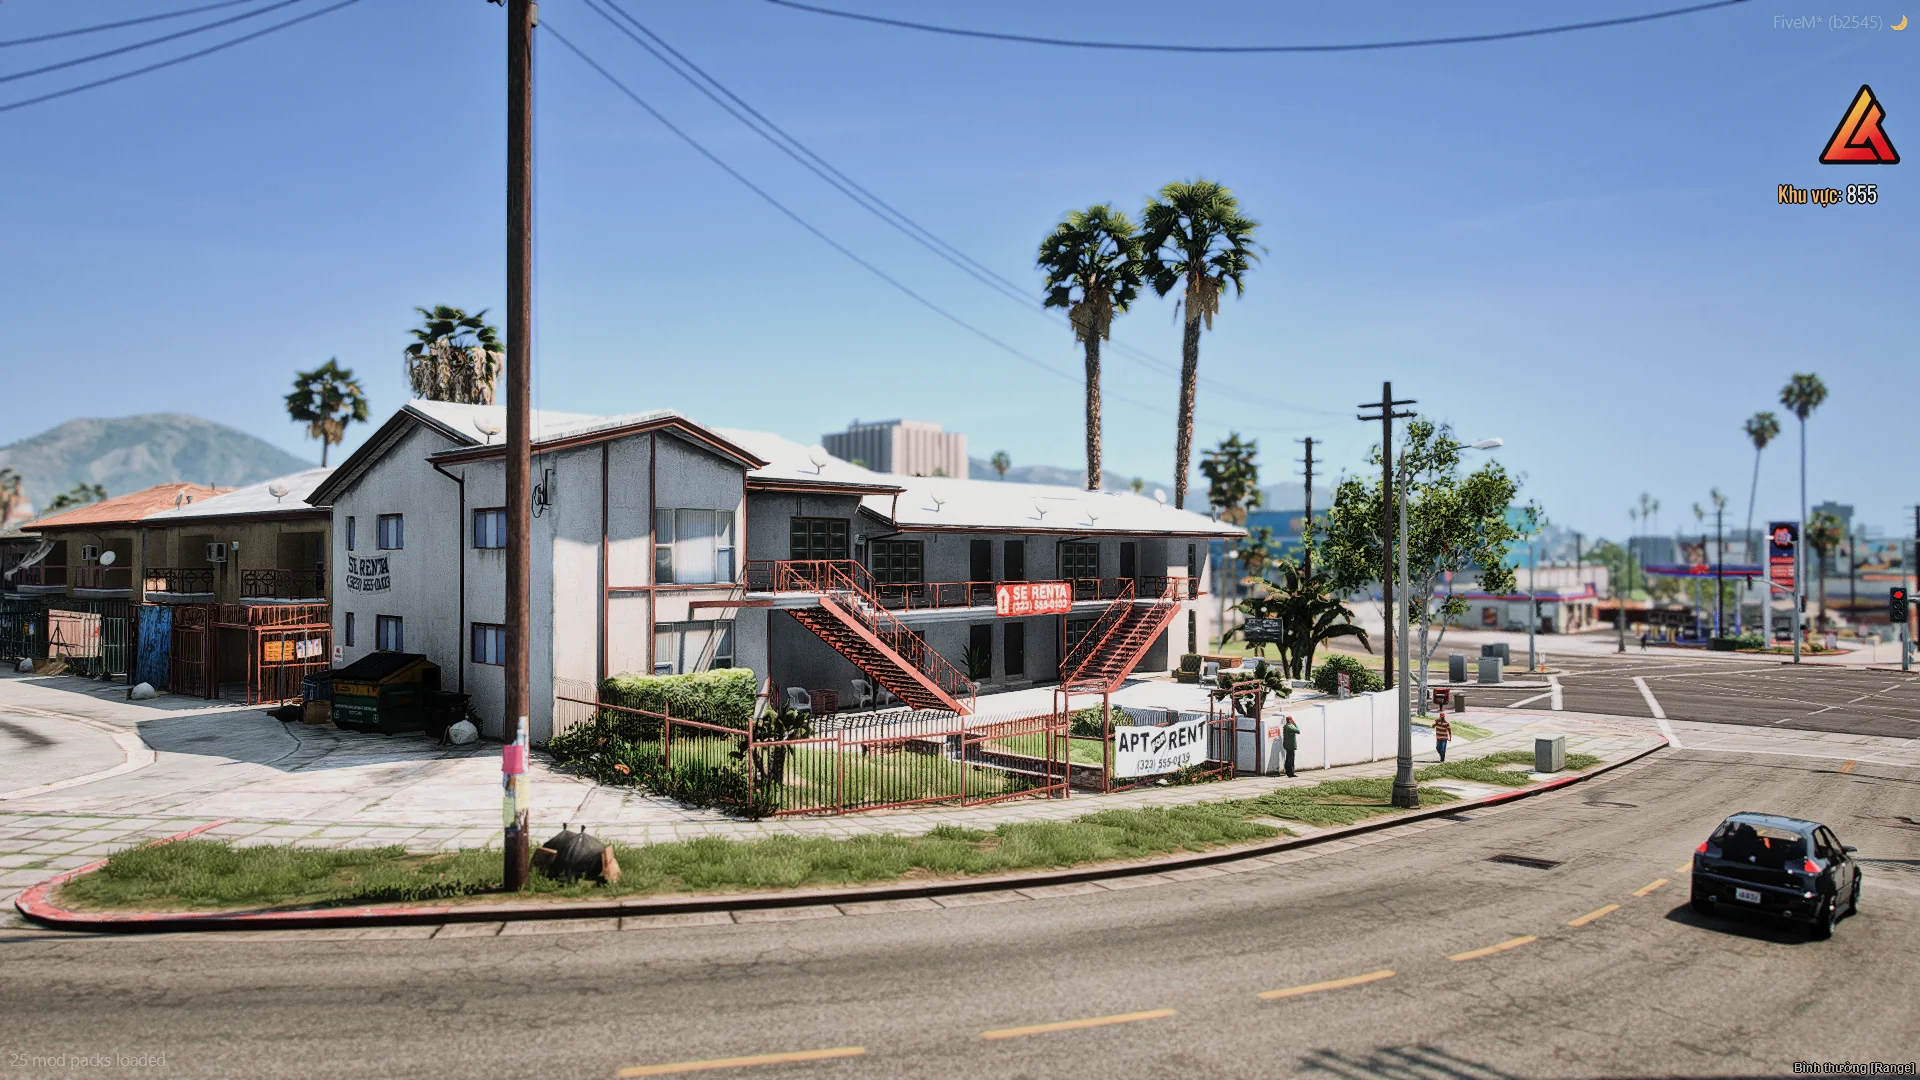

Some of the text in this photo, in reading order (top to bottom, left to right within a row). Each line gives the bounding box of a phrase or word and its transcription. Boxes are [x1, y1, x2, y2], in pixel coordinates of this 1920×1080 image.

[360, 557, 389, 576] RENTA
[1013, 583, 1067, 600] SE RENTA
[1119, 732, 1150, 752] APT
[1168, 721, 1206, 750] RENT
[1137, 759, 1156, 773] (323)
